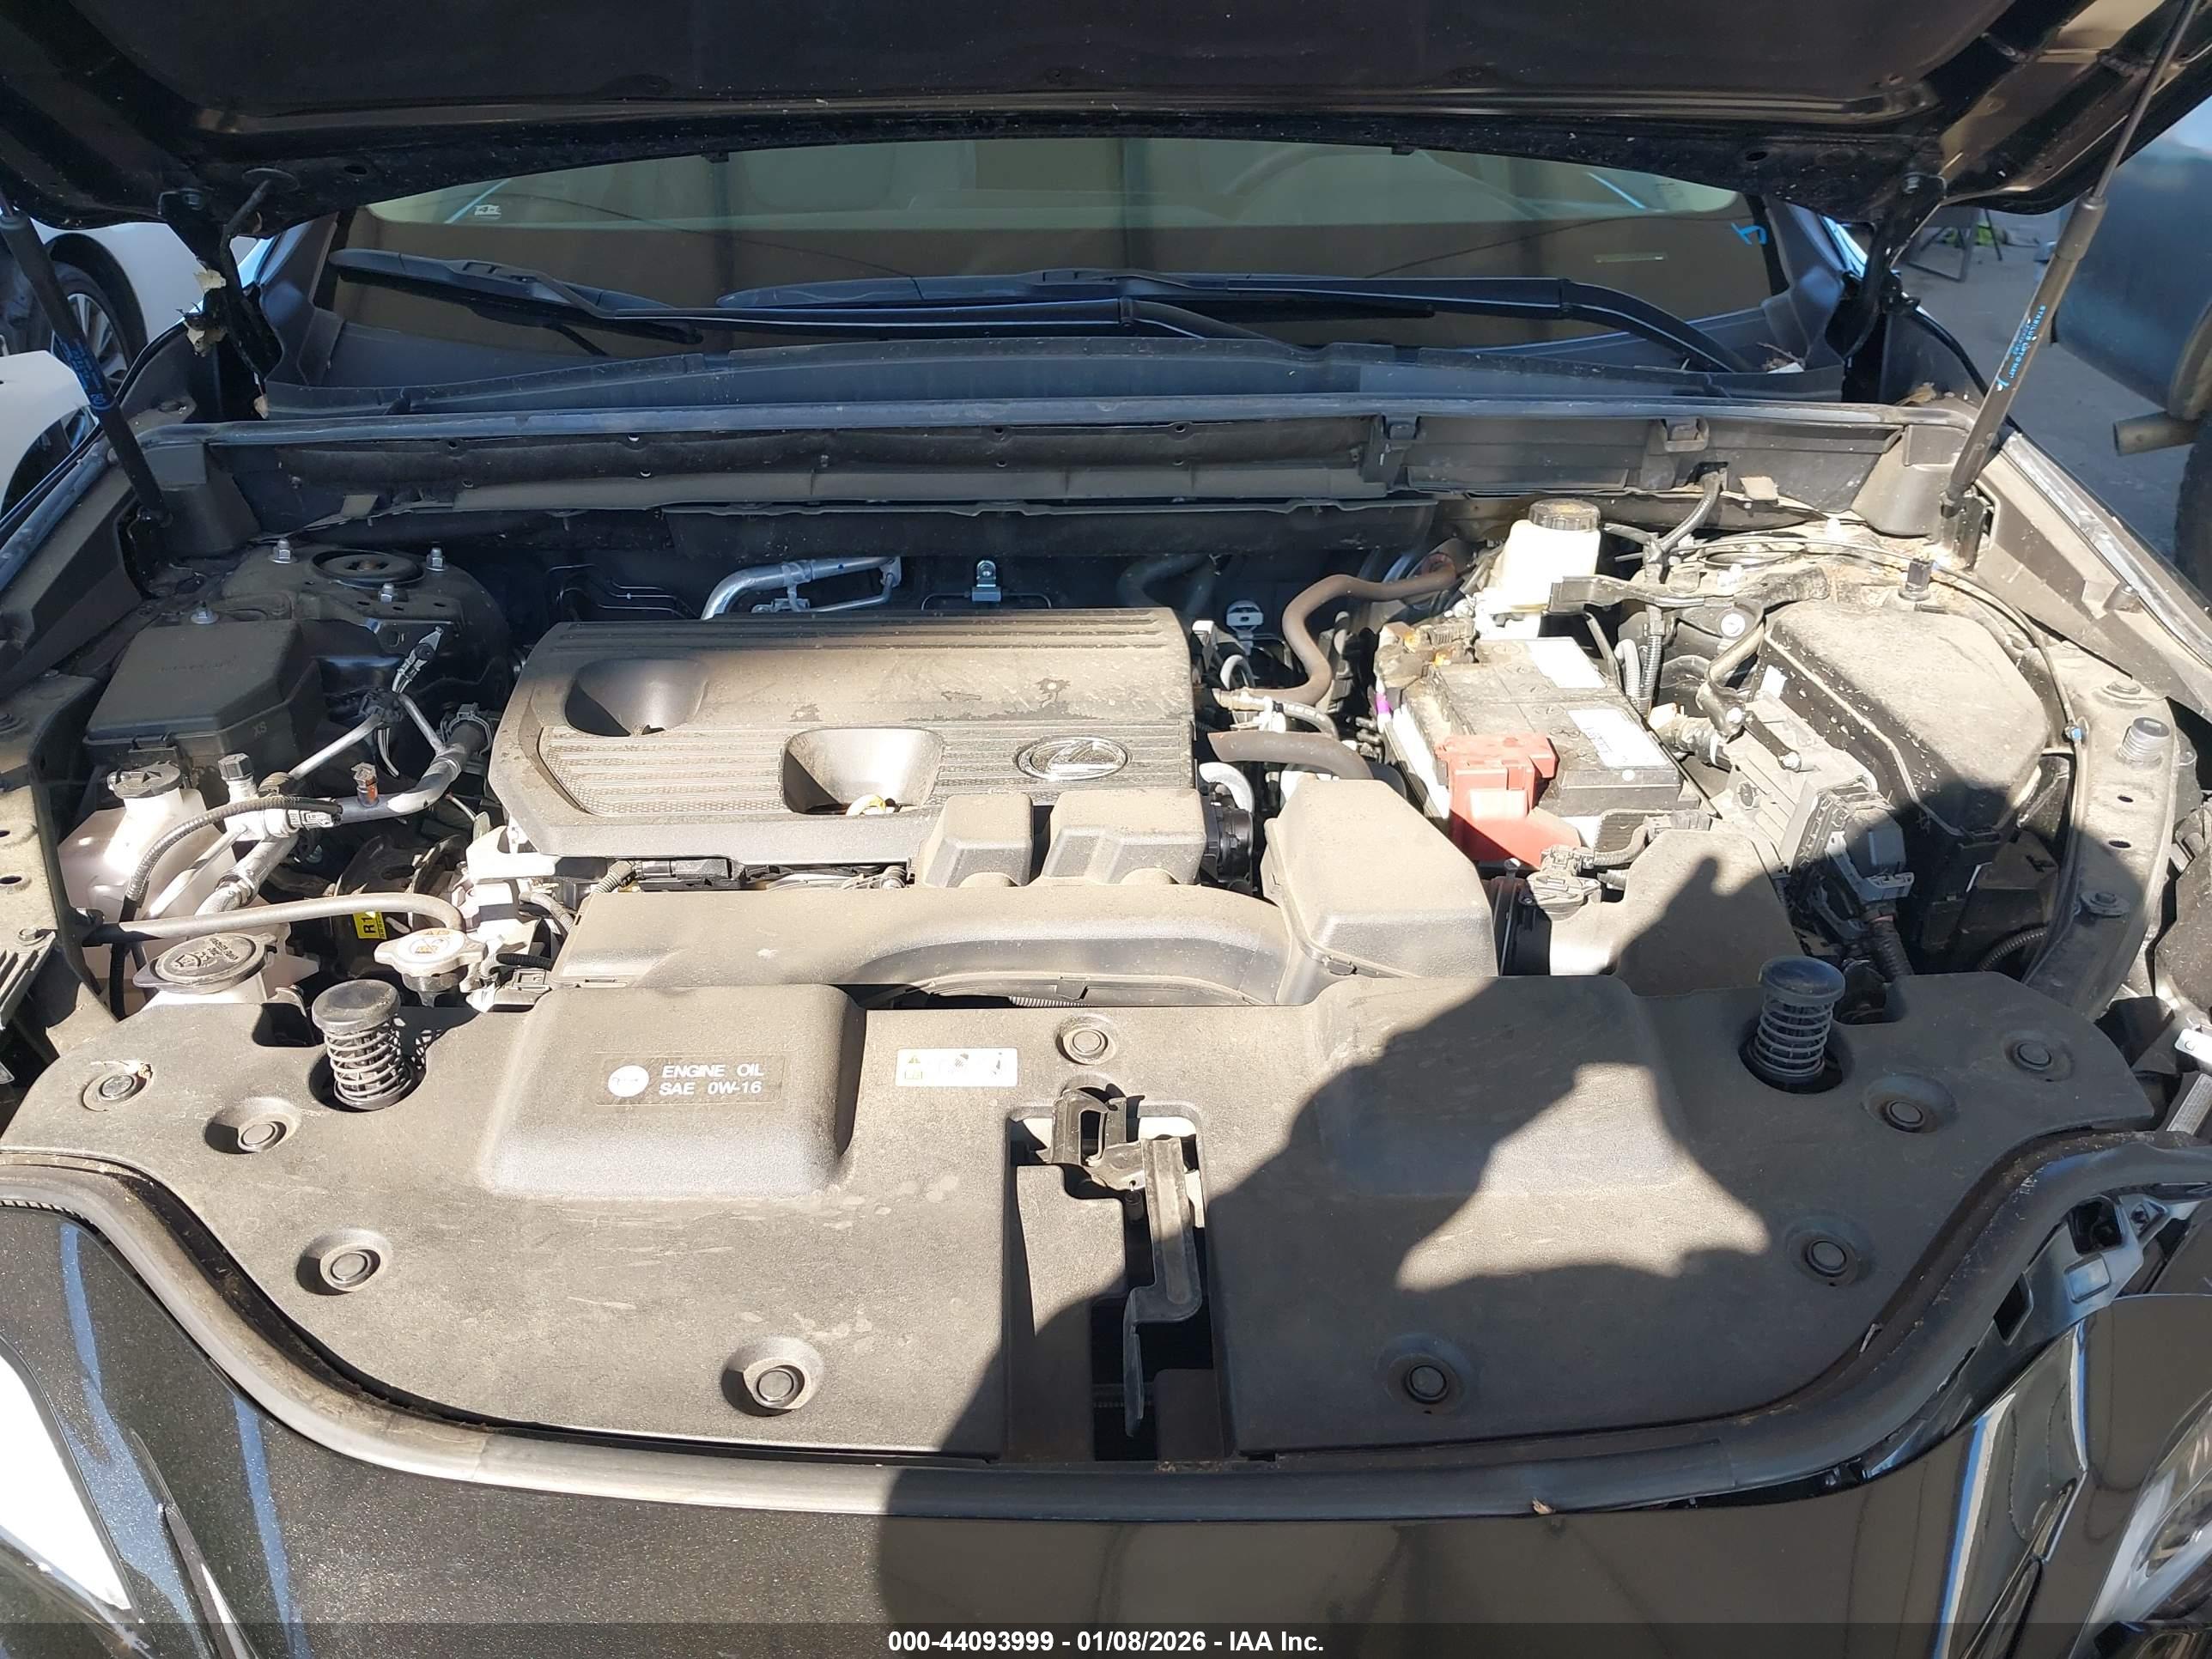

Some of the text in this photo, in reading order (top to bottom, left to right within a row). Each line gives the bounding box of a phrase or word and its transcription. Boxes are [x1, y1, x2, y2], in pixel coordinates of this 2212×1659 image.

[662, 1063, 764, 1079] ENGINE OIL
[659, 1081, 763, 1096] SAE 0W-16
